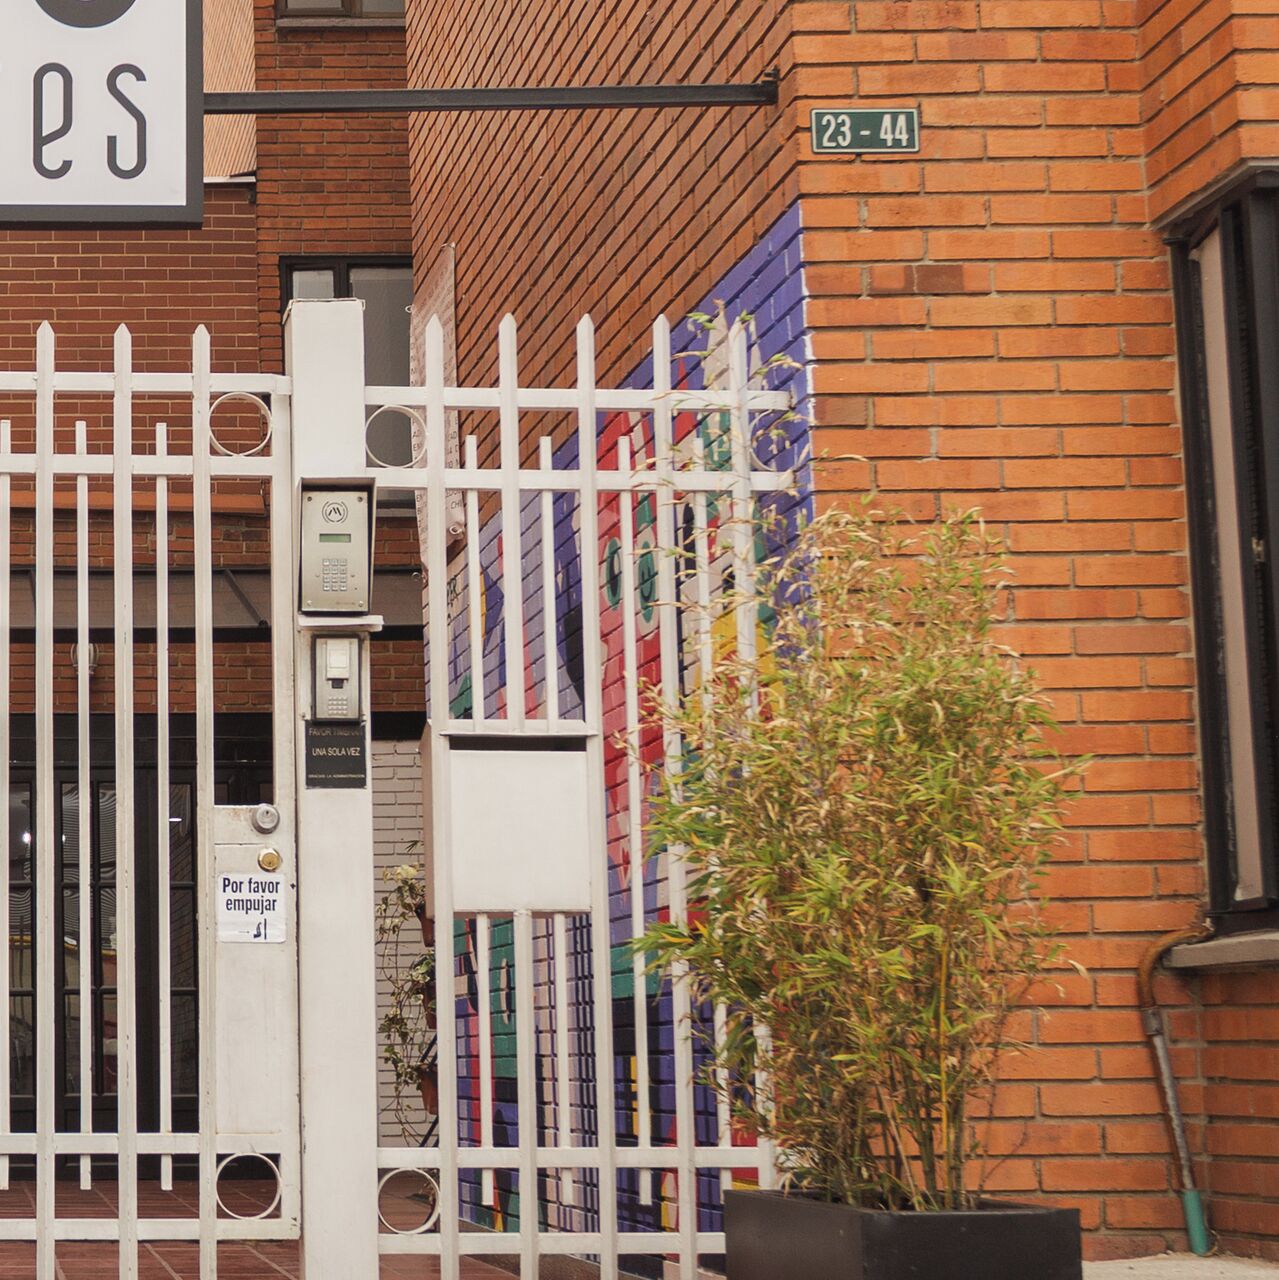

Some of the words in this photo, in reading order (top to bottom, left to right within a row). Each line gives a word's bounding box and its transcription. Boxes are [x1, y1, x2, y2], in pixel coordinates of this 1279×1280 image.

[308, 727, 332, 736] FAVOR
[312, 747, 327, 756] UNA
[327, 747, 347, 756] SOLA
[347, 747, 361, 756] VEZ
[222, 877, 244, 893] Por
[248, 877, 280, 893] favor
[225, 895, 277, 915] empujar
